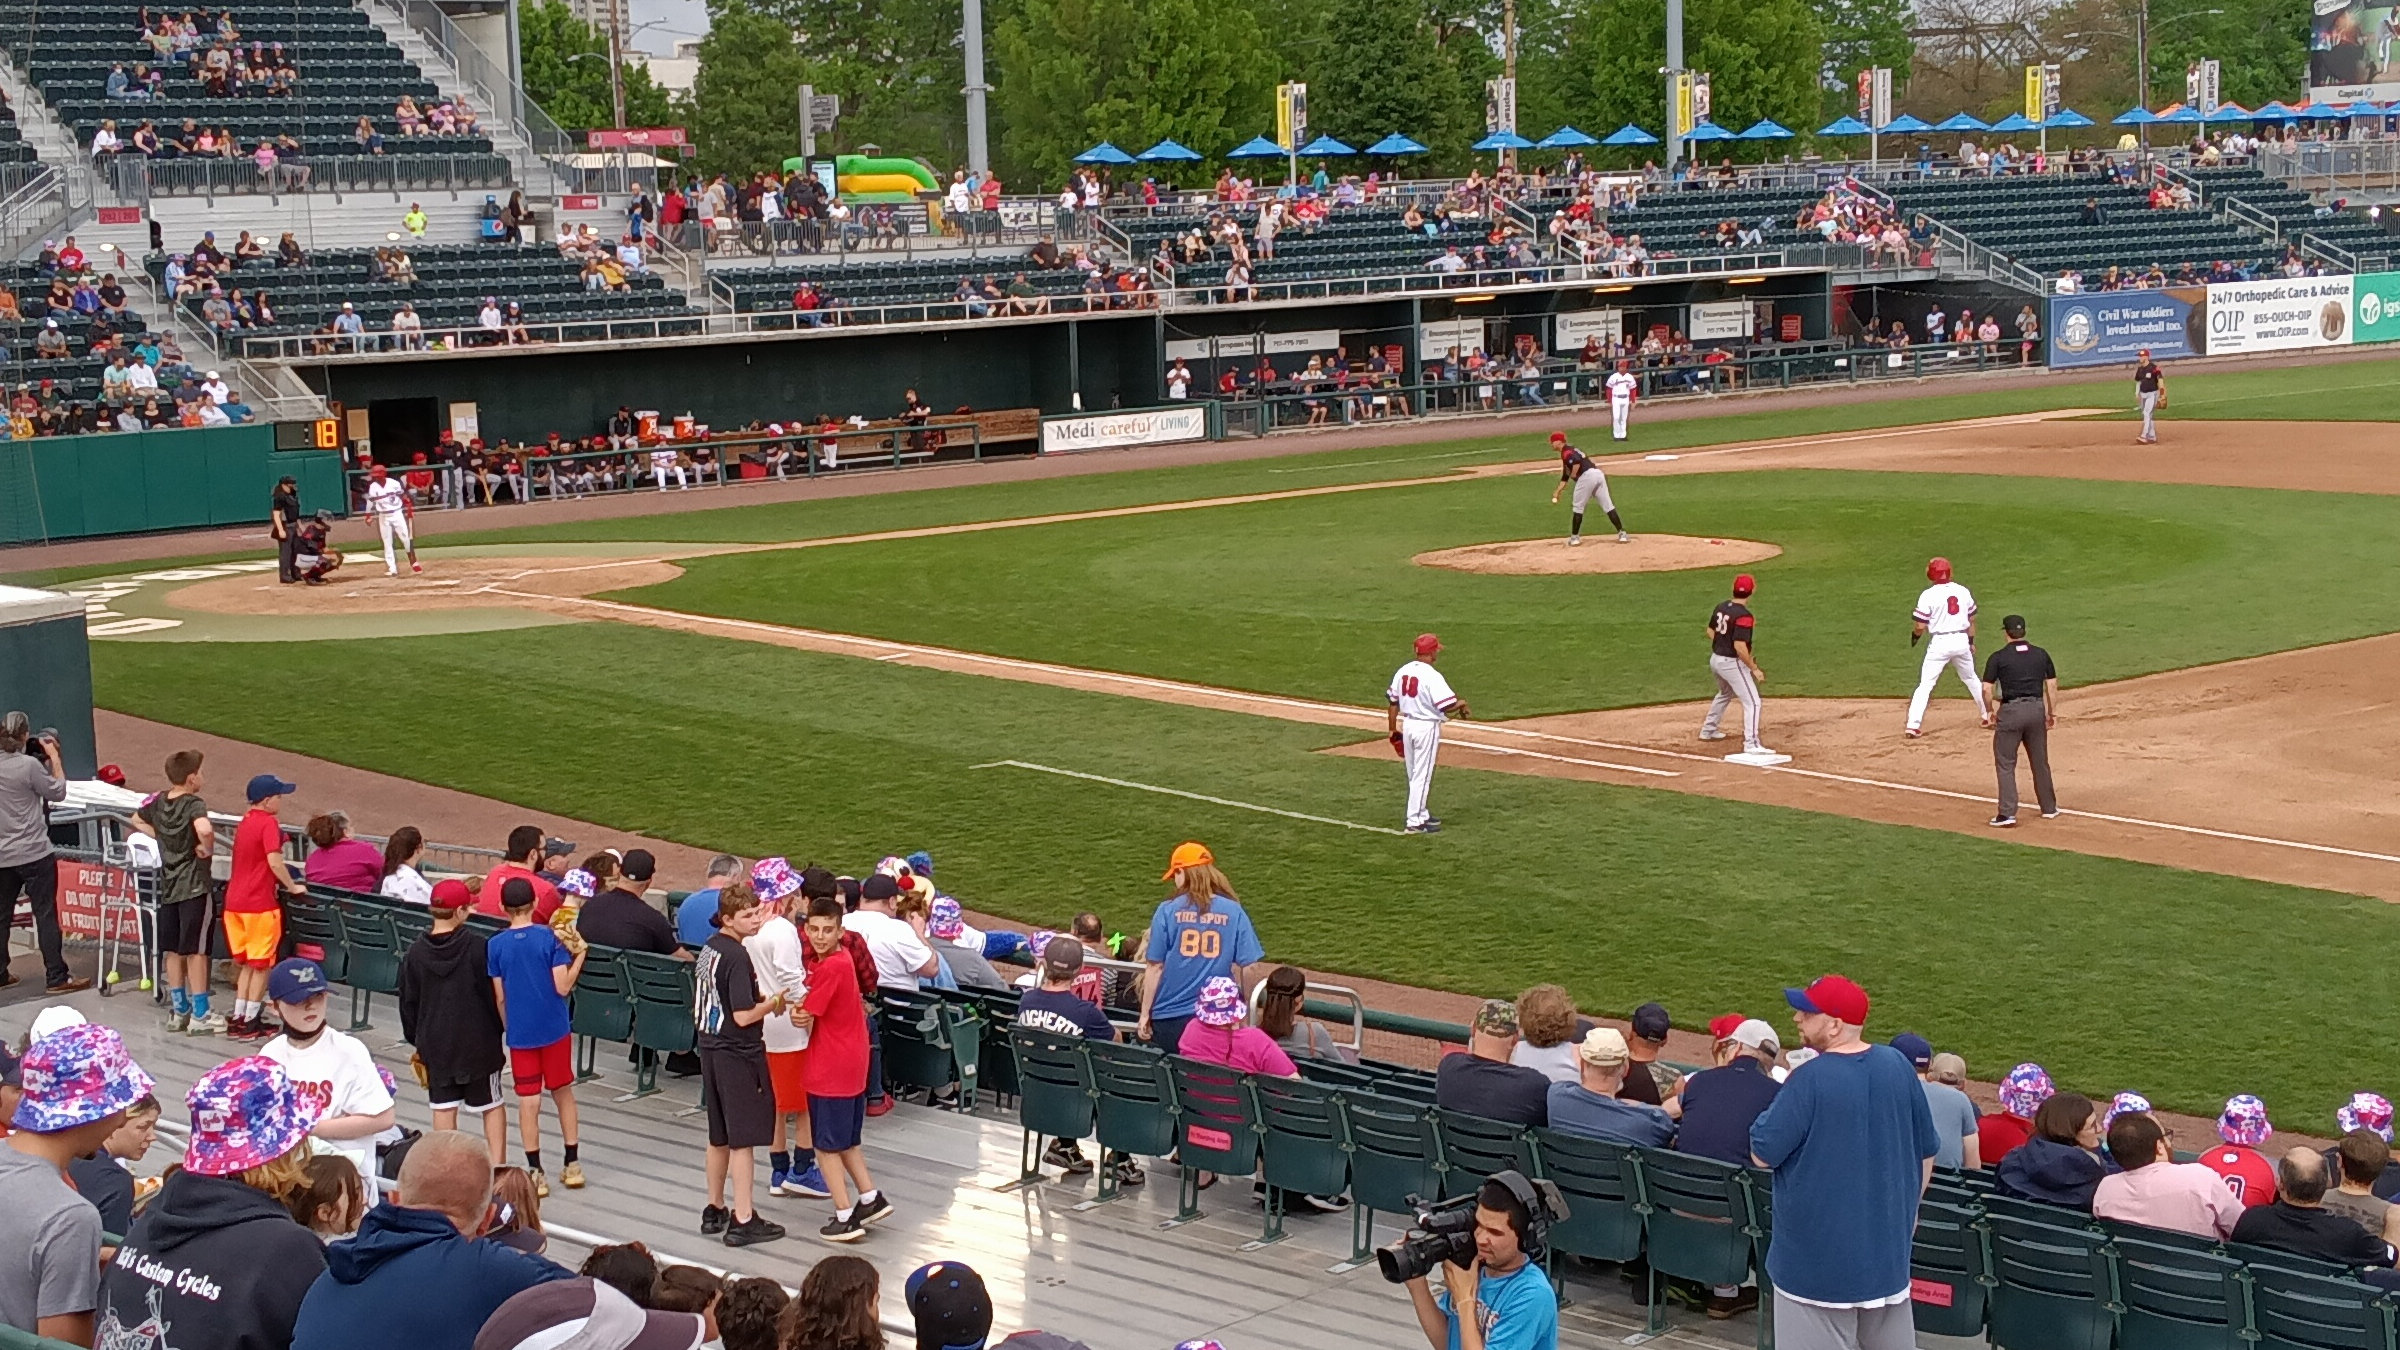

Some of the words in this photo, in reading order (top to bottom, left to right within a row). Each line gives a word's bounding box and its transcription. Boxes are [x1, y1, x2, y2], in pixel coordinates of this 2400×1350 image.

[2207, 63, 2216, 99] Capital
[1503, 81, 1512, 126] Capital
[2337, 88, 2364, 98] Capital
[2211, 289, 2233, 305] 24/7
[2234, 286, 2286, 304] Orthopedic
[2287, 284, 2309, 298] Care
[2310, 285, 2318, 297] &
[2319, 282, 2350, 297] Advice
[2098, 308, 2120, 322] Civil
[2121, 308, 2140, 320] War
[2141, 306, 2174, 319] soldiers
[2212, 310, 2245, 334] OIP
[2253, 309, 2312, 325] 855-OUCH-OIP
[2106, 324, 2130, 337] loved
[2130, 320, 2165, 335] baseball
[2165, 321, 2183, 332] too.
[2256, 327, 2309, 340] www.OIP.com
[316, 420, 337, 448] 18
[1056, 421, 1095, 440] Medi
[1100, 417, 1151, 437] careful
[1160, 415, 1190, 431] LIVING
[1715, 612, 1730, 635] 35
[79, 869, 114, 888] PLEAE
[79, 892, 97, 909] NOT
[1174, 911, 1198, 924] THE
[1199, 912, 1229, 926] SPOT
[1180, 928, 1220, 959] 80
[135, 1254, 175, 1288] Custom
[176, 1267, 222, 1301] Cycles
